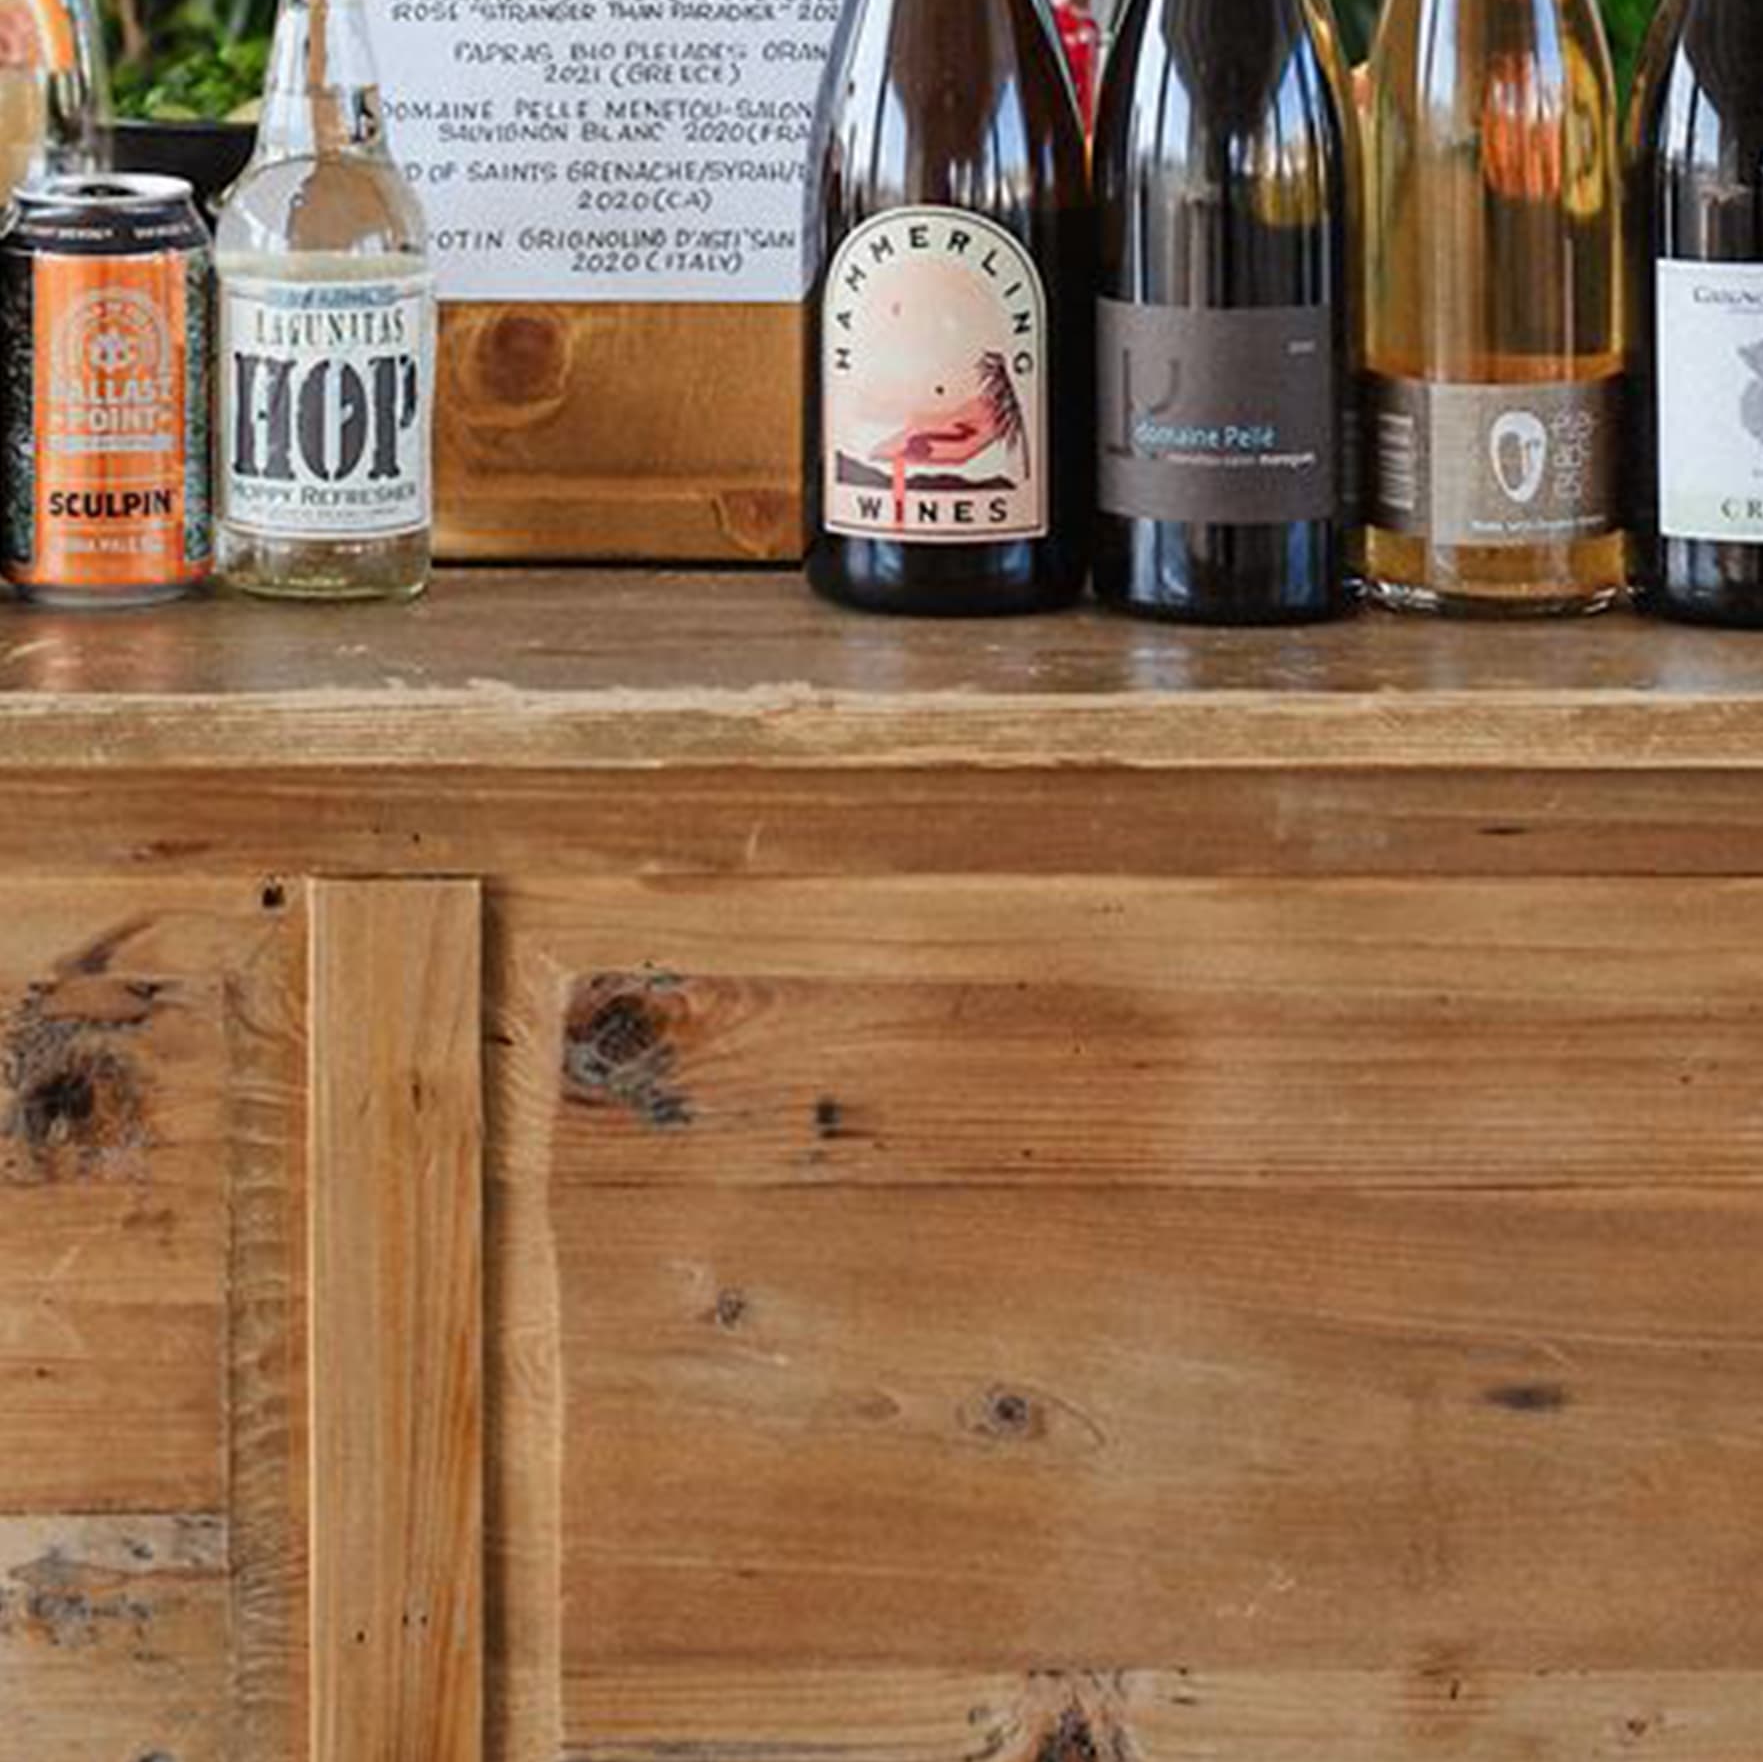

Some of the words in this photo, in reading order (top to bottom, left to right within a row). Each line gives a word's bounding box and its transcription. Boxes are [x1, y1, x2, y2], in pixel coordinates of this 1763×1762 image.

[606, 1, 663, 22] THAN
[569, 41, 617, 62] BIO
[761, 39, 829, 63] ORAN
[543, 63, 600, 84] 2021
[609, 61, 742, 88] (GREECE)
[437, 122, 569, 144] SAUVIGNON
[580, 123, 667, 144] BLANC
[428, 161, 461, 183] OF
[466, 160, 558, 183] SAINTS
[429, 229, 503, 250] OTIN
[836, 226, 1033, 375] HAMMERLING
[256, 308, 405, 348] LAGUNITAS
[233, 351, 417, 482] HOP
[48, 489, 172, 518] SCULPIN
[858, 497, 1008, 525] WINES
